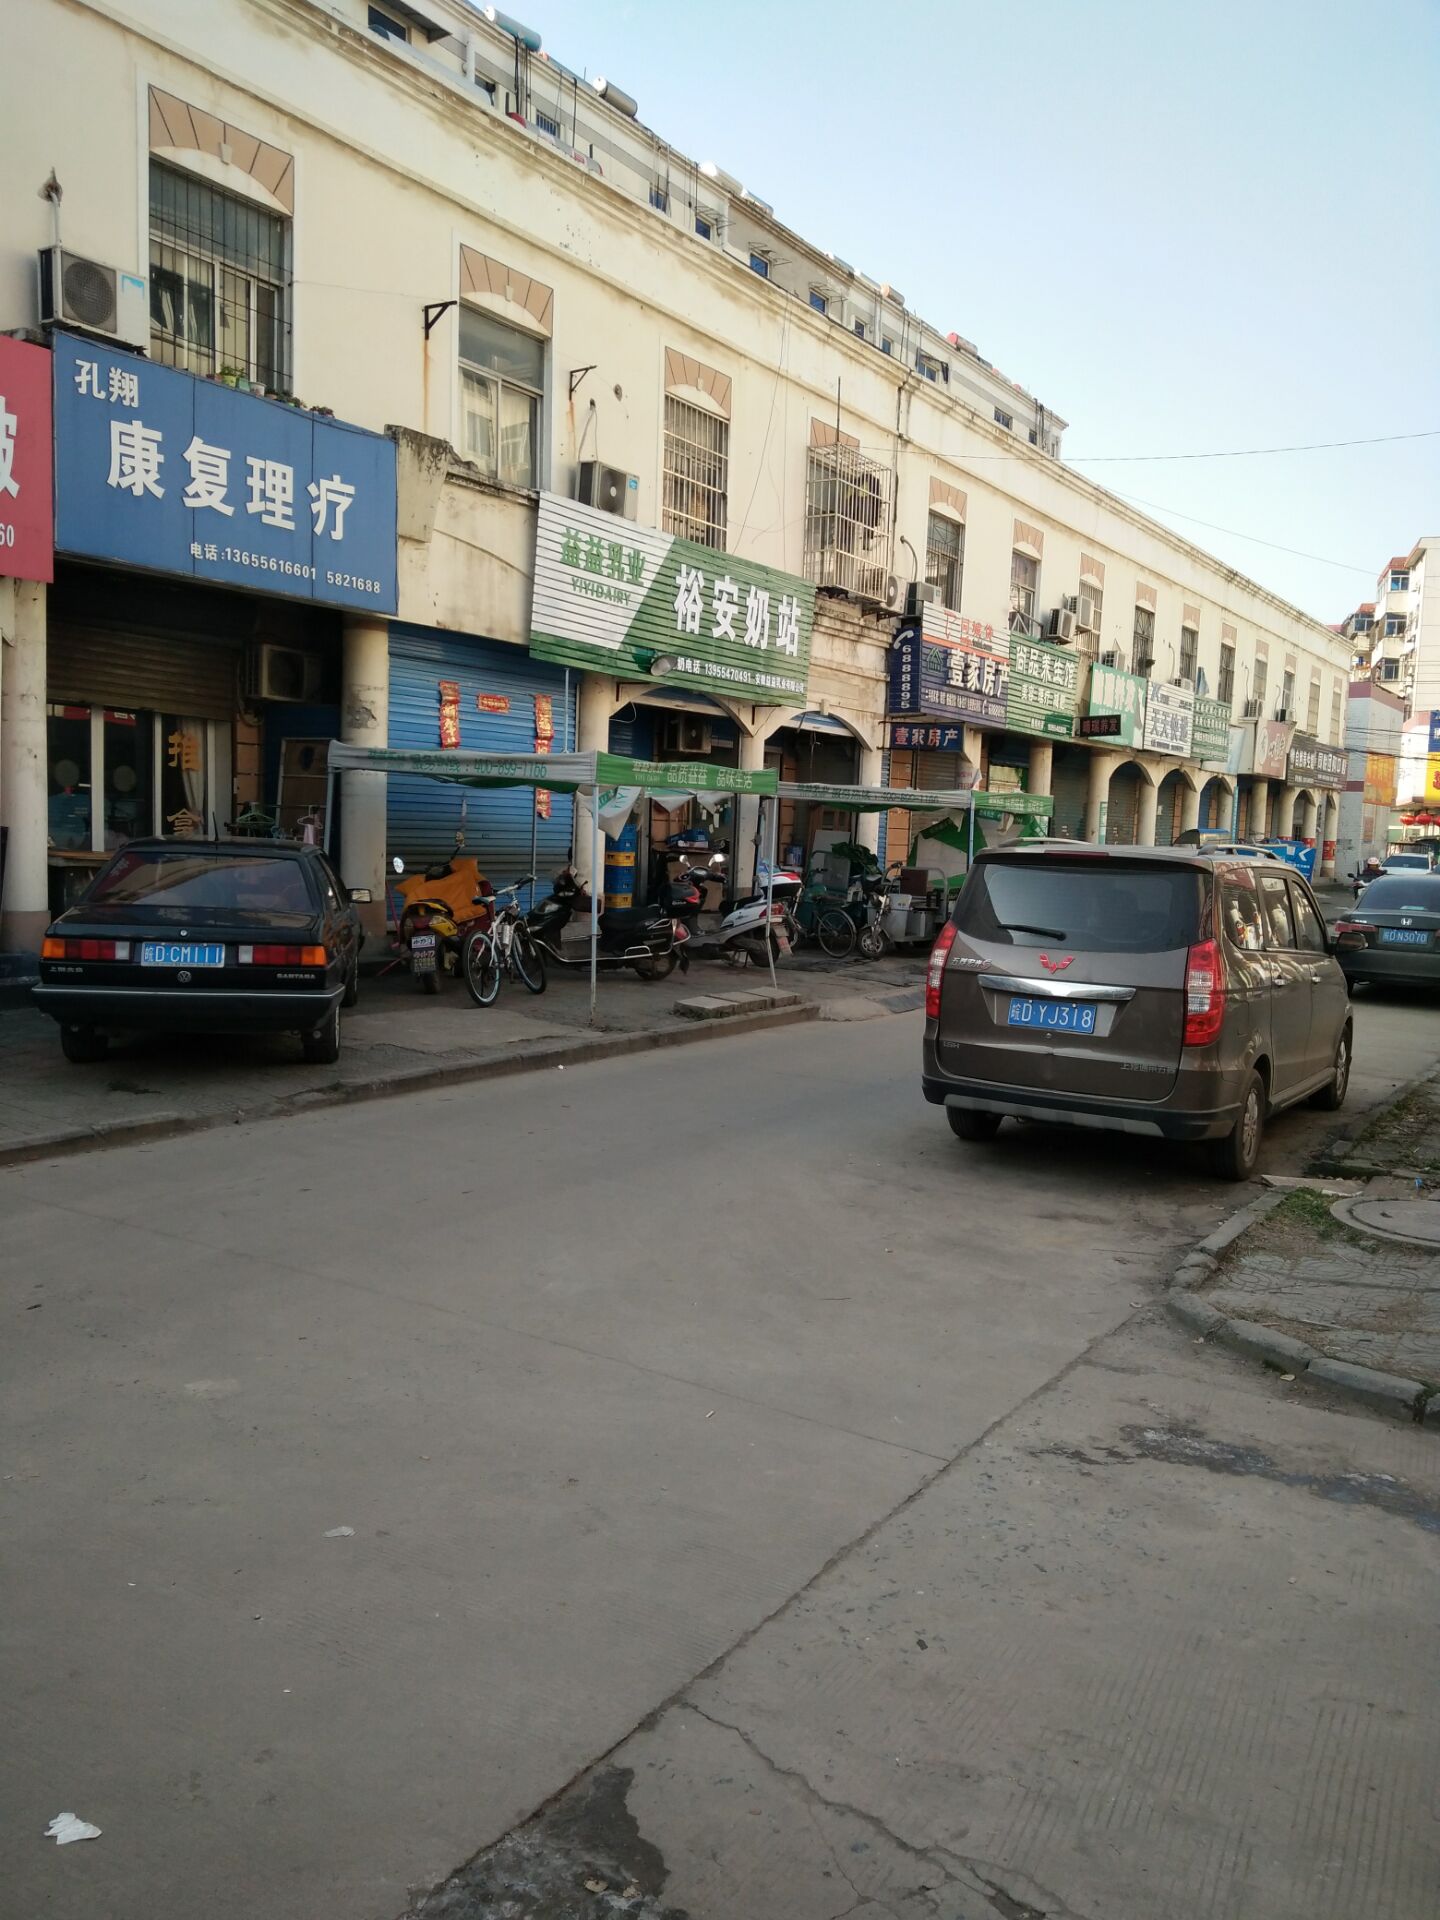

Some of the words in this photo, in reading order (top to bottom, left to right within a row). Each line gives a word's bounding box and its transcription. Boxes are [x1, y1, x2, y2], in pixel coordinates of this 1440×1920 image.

[74, 359, 139, 408] 孔翔
[107, 420, 356, 541] 康复理疗
[560, 527, 646, 587] 益益乳业
[326, 571, 381, 594] 5821688
[673, 563, 801, 658] 裕安奶站
[673, 656, 701, 675] 奶电话
[900, 644, 912, 709] 6888895
[946, 647, 1010, 698] 壹家房产
[894, 726, 959, 748] 壹家房产
[667, 764, 708, 786] 品质益益
[716, 770, 753, 790] 品味生活
